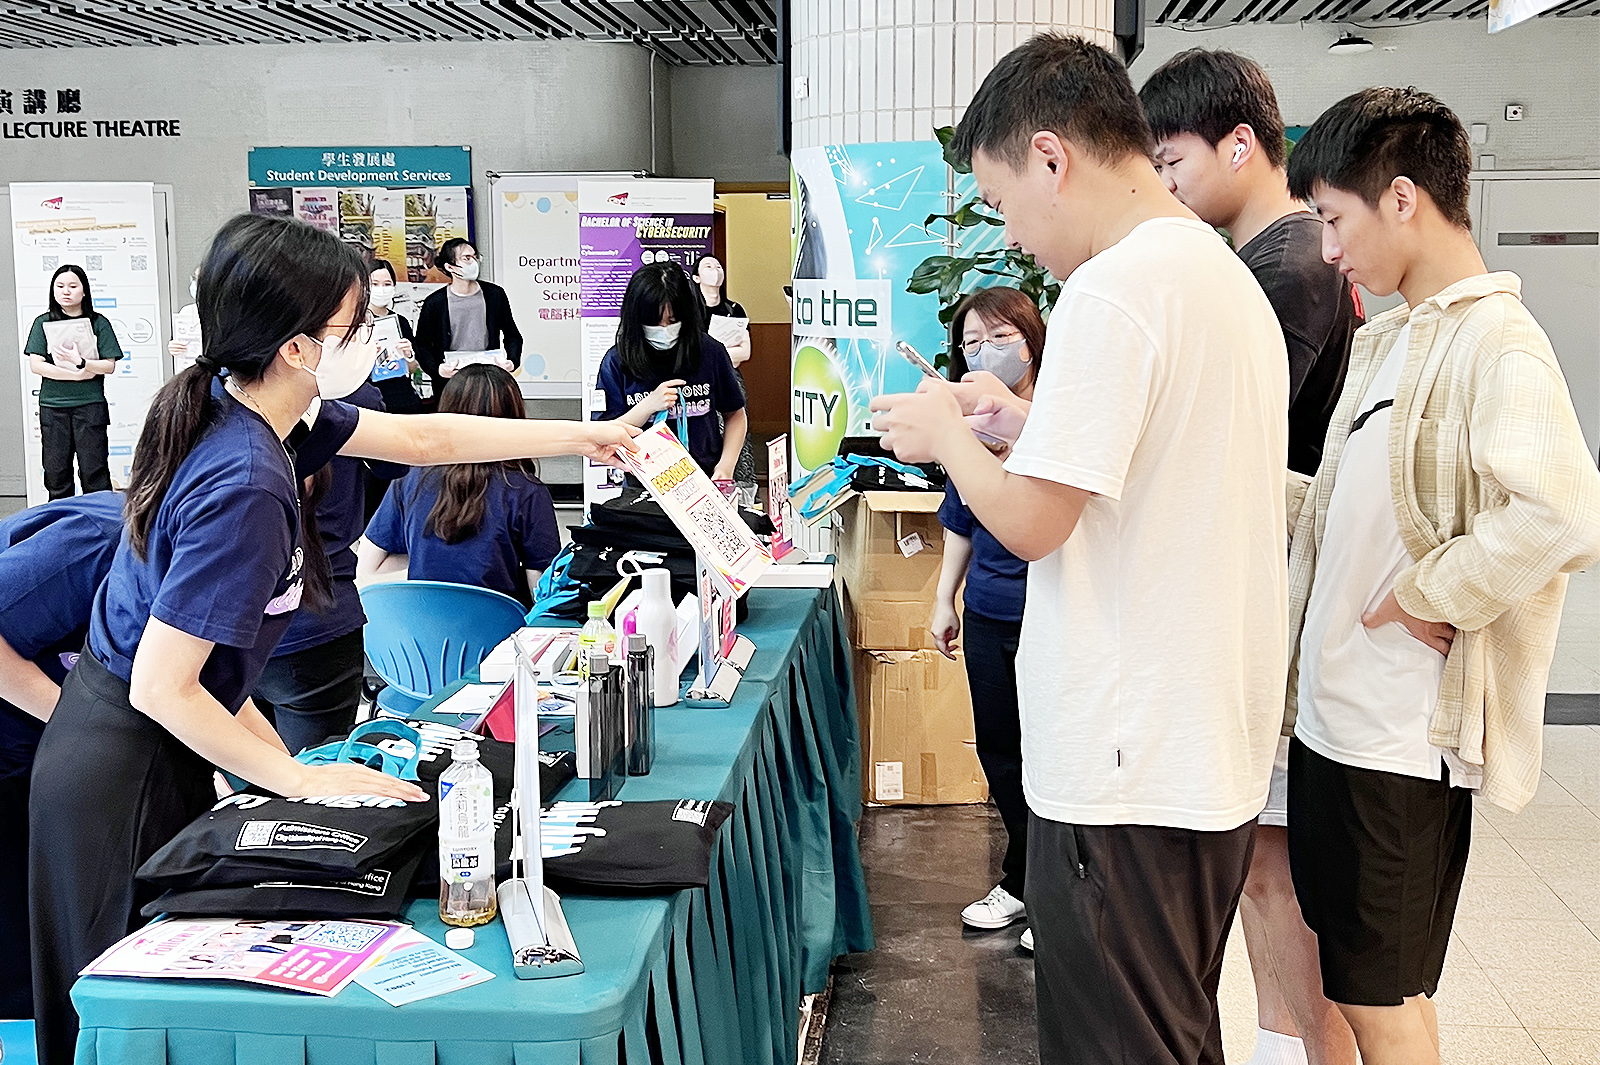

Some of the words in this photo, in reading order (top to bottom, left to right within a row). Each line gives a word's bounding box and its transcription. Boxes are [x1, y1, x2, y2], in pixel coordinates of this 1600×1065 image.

[3, 121, 88, 139] LECTURE
[93, 119, 181, 137] THEATRE
[321, 152, 396, 167] 學生發展處
[266, 169, 315, 182] Student
[317, 169, 399, 183] Development
[402, 169, 452, 182] Services
[635, 226, 712, 239] CYBERSECURITY
[796, 289, 813, 325] to
[821, 289, 878, 327] the
[793, 390, 839, 427] CITY
